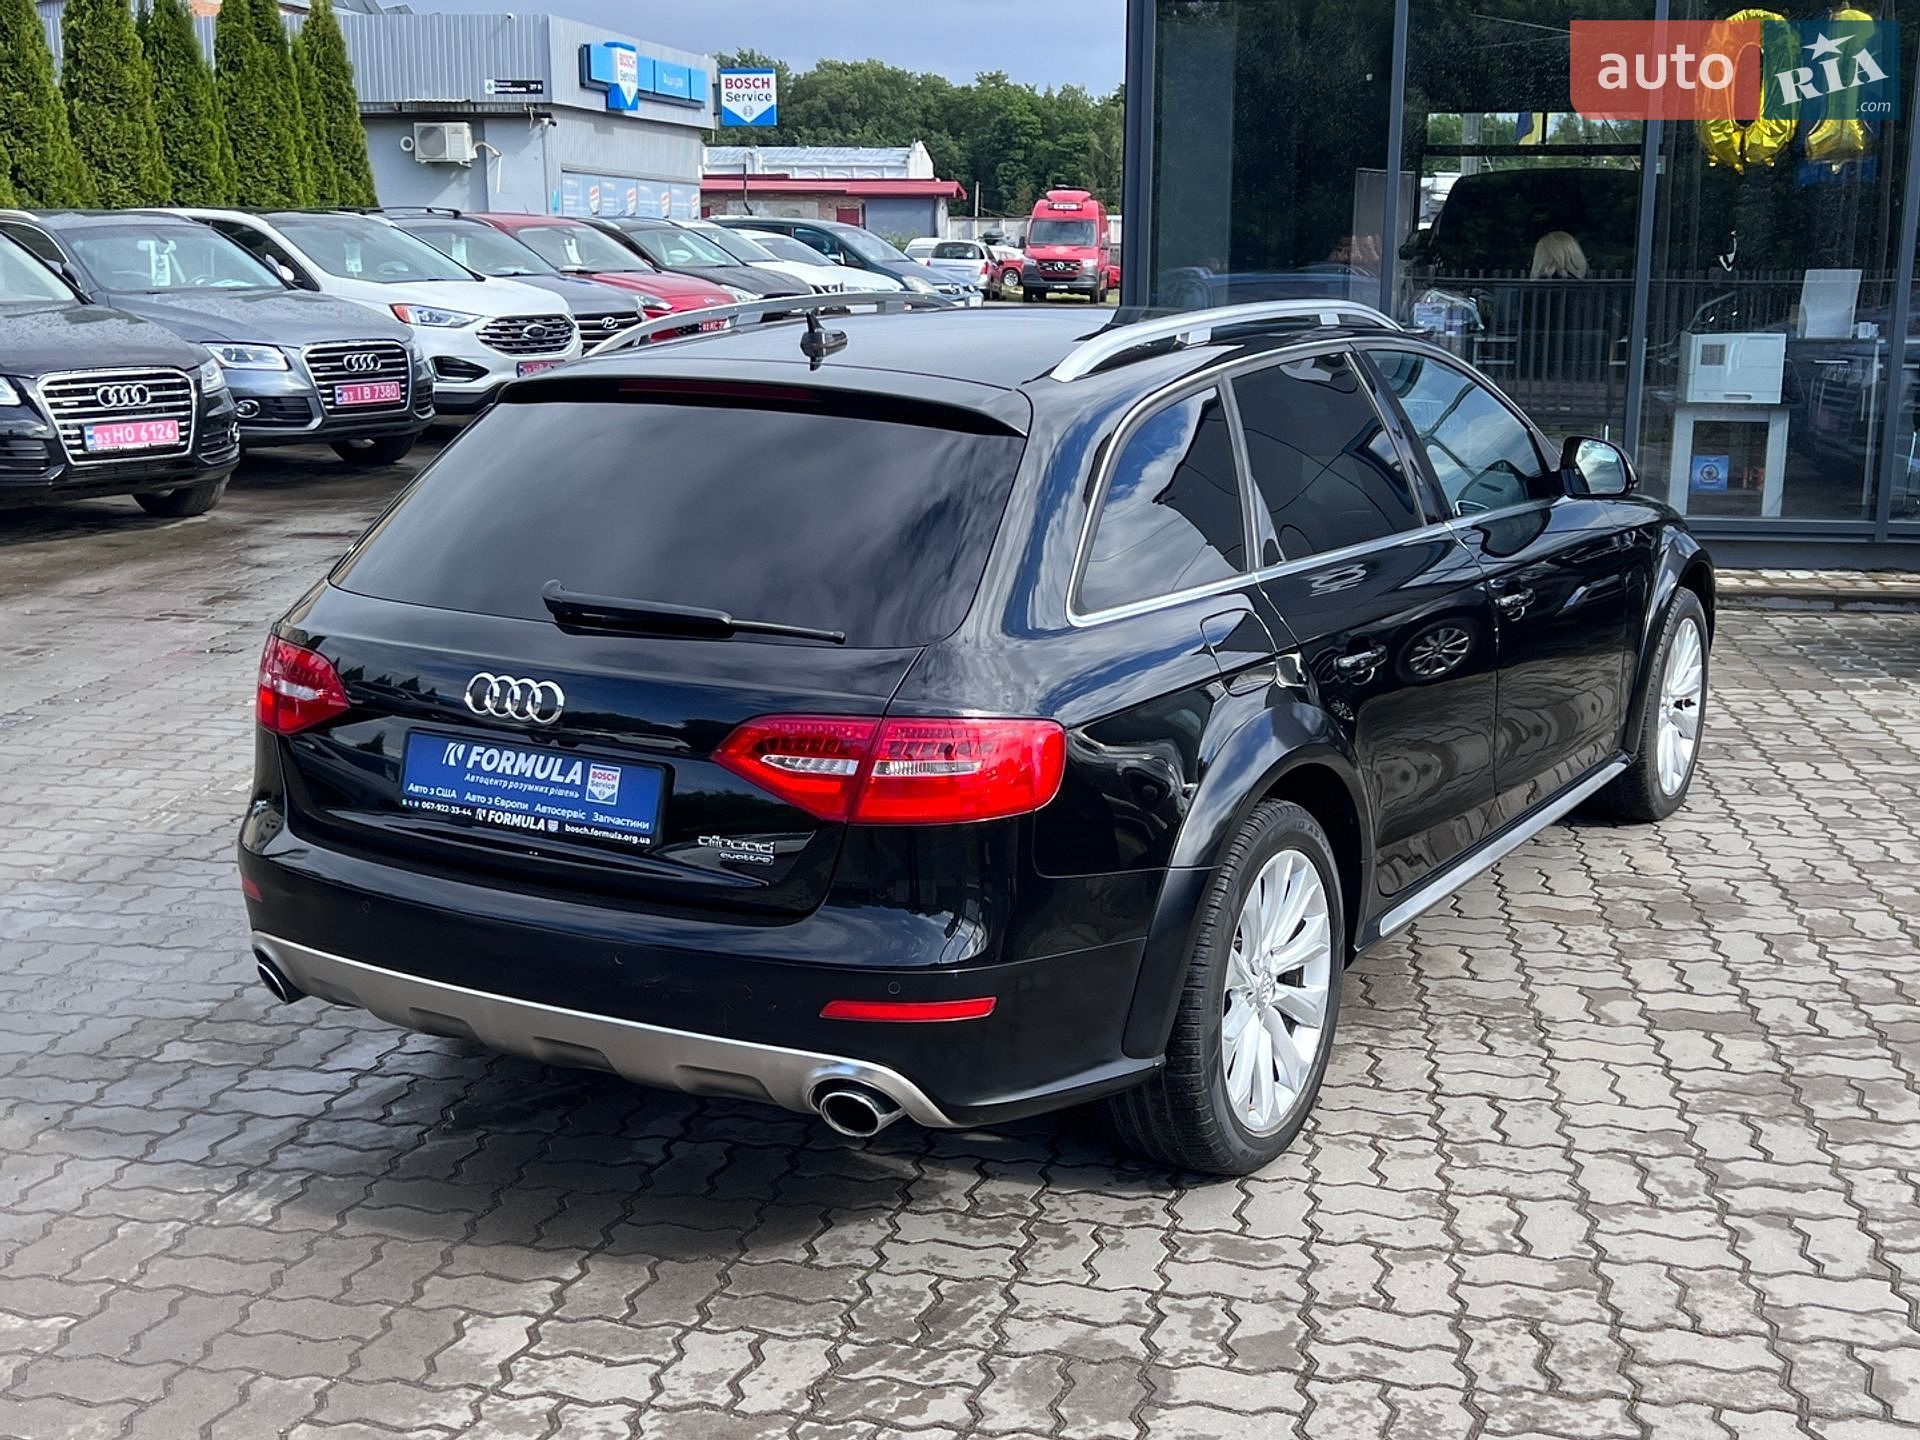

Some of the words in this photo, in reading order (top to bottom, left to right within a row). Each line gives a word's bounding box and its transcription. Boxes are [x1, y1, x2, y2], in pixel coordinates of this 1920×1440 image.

[725, 77, 771, 90] BOSCH
[725, 90, 772, 103] Service
[374, 384, 397, 398] 7380
[140, 422, 175, 441] 6126
[467, 745, 583, 785] FORMULA
[591, 770, 617, 782] BOSCH
[408, 783, 428, 794] Авто
[435, 787, 457, 799] США
[464, 772, 507, 789] Автоцентр
[549, 786, 580, 799] рішень
[590, 780, 616, 791] Service
[464, 792, 487, 803] Авто
[494, 797, 529, 811] Європи
[534, 803, 587, 820] Автосервіс
[487, 810, 546, 831] FORMULA
[565, 824, 651, 845] bosch.formula.org.ua
[592, 812, 650, 830] Запчастини
